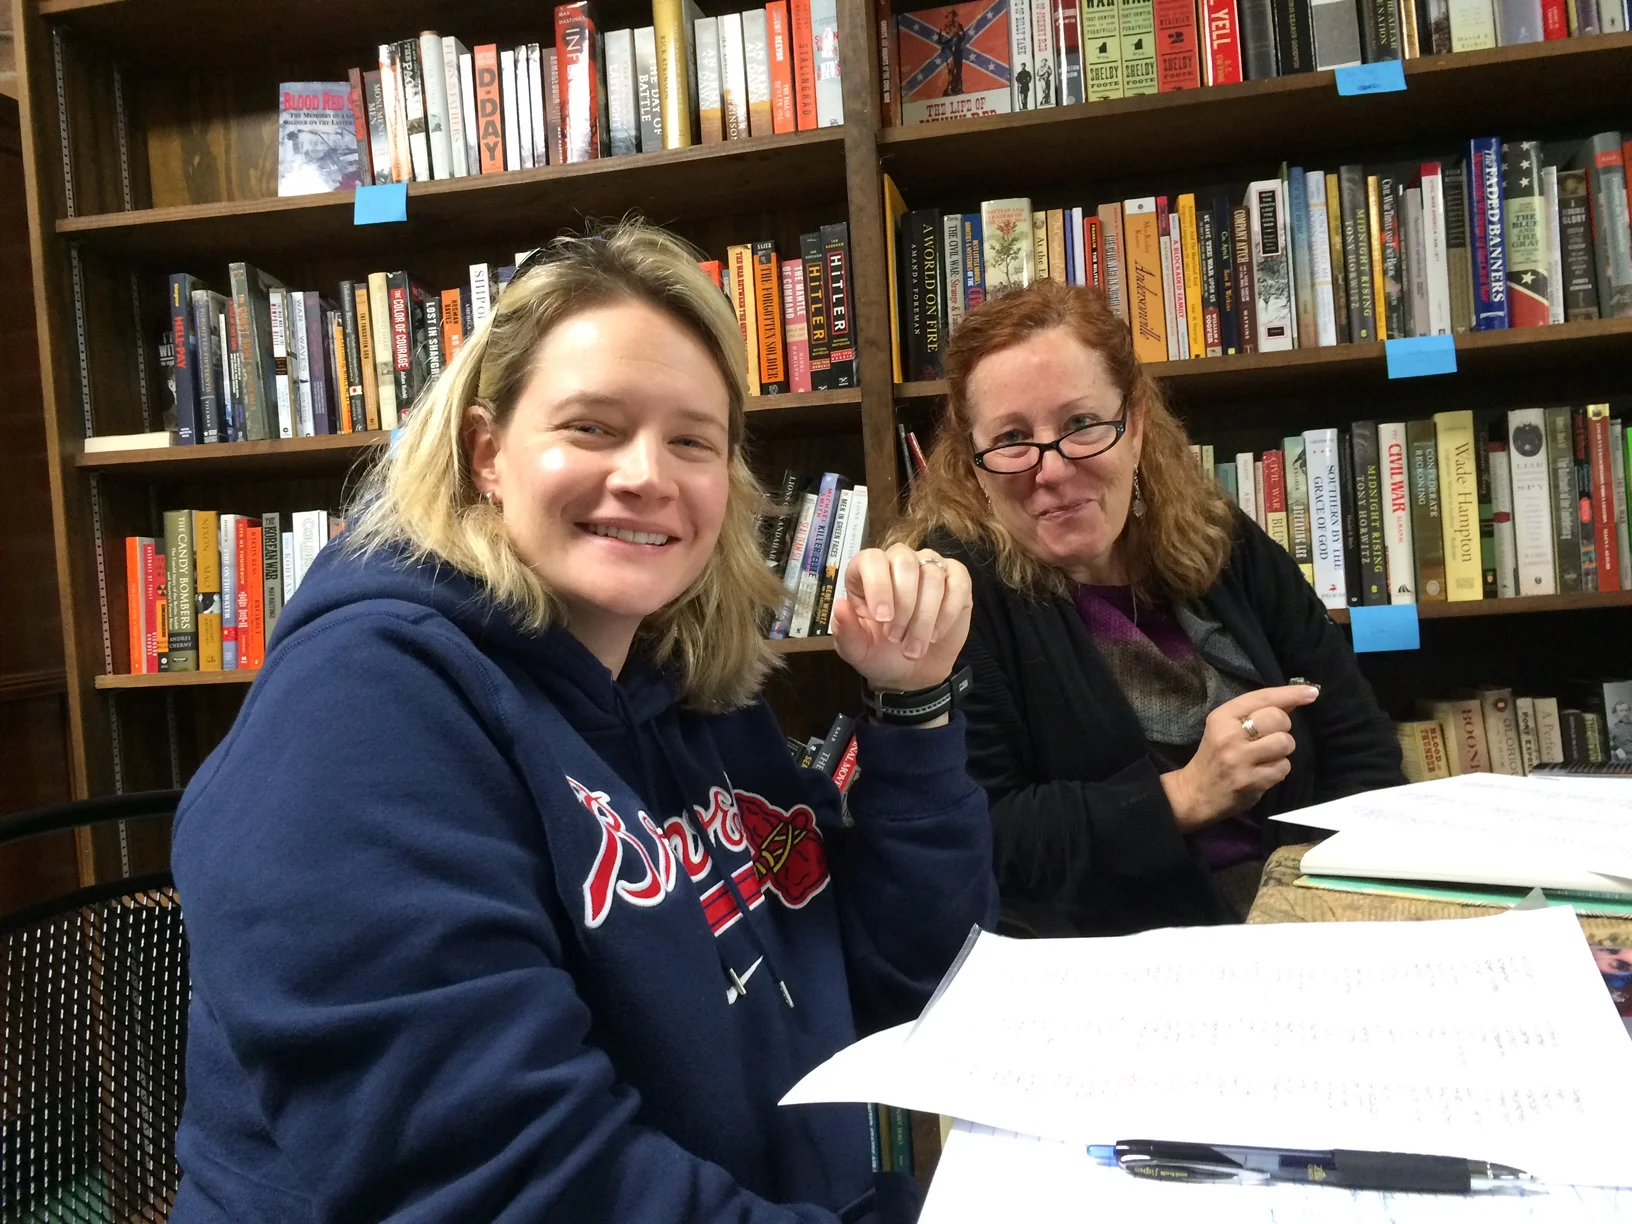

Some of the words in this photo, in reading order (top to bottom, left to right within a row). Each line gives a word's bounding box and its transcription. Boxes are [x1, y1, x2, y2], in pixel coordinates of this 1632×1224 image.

[1211, 8, 1231, 50] YELL
[1377, 8, 1387, 45] NATION
[609, 63, 619, 91] LAST
[1090, 65, 1119, 81] SHELBY
[1125, 62, 1155, 78] SHELBY
[1163, 56, 1193, 72] SHELBY
[1164, 71, 1194, 79] FOOTE
[799, 44, 811, 116] STALINGRAD
[1090, 81, 1120, 89] FOOTE
[1126, 78, 1155, 86] FOOTE
[322, 91, 345, 110] RED
[610, 95, 622, 128] LIGHT
[639, 75, 651, 122] BATTLE
[651, 89, 661, 112] DAY
[926, 104, 947, 117] THE
[950, 100, 972, 114] LIFE
[975, 97, 986, 110] OF
[1486, 167, 1500, 222] FADED
[923, 224, 933, 232] A
[1234, 209, 1247, 240] COMPANY
[1514, 213, 1537, 222] THE
[948, 225, 958, 239] THE
[1037, 237, 1045, 247] At
[1345, 220, 1355, 250] TONY
[1356, 208, 1369, 272] MIDNIGHT
[1515, 233, 1537, 241] THE
[923, 235, 936, 289] WORLD
[949, 240, 959, 258] CIVIL
[1038, 251, 1046, 264] the
[1236, 242, 1249, 263] AYTCH
[761, 267, 773, 285] THE
[782, 266, 791, 275] OF
[794, 266, 804, 282] THE
[911, 243, 919, 283] AMANDA
[1173, 247, 1182, 291] BLOCKADED
[1488, 224, 1504, 302] BANNERS
[474, 270, 485, 303] SHIP
[950, 279, 960, 305] Strange
[1348, 254, 1359, 309] HORWITZ
[784, 276, 794, 319] COMMAND
[795, 284, 806, 316] MANTLE
[925, 294, 937, 315] ON
[1135, 259, 1161, 342] Andersonville
[1209, 295, 1216, 303] US
[1361, 275, 1372, 316] RISING
[394, 299, 405, 323] COLOR
[426, 302, 436, 323] LOST
[451, 299, 459, 324] NORMAN
[762, 287, 776, 340] FORGOTTEN
[913, 288, 921, 334] FOREMAN
[174, 316, 185, 343] HELL
[396, 324, 405, 333] OF
[428, 325, 438, 337] IN
[926, 320, 938, 352] FIRE
[176, 347, 187, 368] PAY
[299, 335, 307, 371] WAVES
[397, 335, 409, 369] COURAGE
[766, 342, 779, 380] SOLDIER
[1268, 457, 1279, 483] CIVIL
[1388, 443, 1404, 480] CIVIL
[1455, 442, 1473, 484] Wade
[786, 476, 796, 500] LIONS
[1356, 475, 1366, 506] TONY
[1415, 450, 1426, 505] RECKONING
[1426, 449, 1437, 517] CONFEDERATE
[816, 493, 825, 519] SMITH
[821, 487, 833, 524] MICHAEL
[1272, 488, 1280, 509] WAR
[1313, 476, 1325, 514] GRACE
[1326, 465, 1340, 525] SOUTHERN
[1367, 465, 1379, 527] MIDNIGHT
[1391, 480, 1406, 513] WAR
[178, 516, 187, 532] THE
[202, 518, 211, 552] NIXON
[834, 519, 844, 540] GREEN
[1293, 505, 1304, 543] DEFEATING
[1317, 516, 1327, 533] OF
[1331, 530, 1340, 542] BY
[1359, 510, 1370, 564] HORWITZ
[1454, 491, 1473, 562] Hampton
[239, 539, 245, 548] ME
[264, 526, 278, 561] KOREAN
[815, 525, 826, 553] KILLER
[830, 540, 839, 557] FACES
[1295, 545, 1306, 558] LEE
[1318, 535, 1328, 560] GOD
[177, 534, 189, 574] CANDY
[1333, 549, 1342, 570] THE
[1371, 532, 1382, 573] RISING
[203, 565, 211, 588] MAO
[224, 566, 230, 577] ON
[265, 562, 278, 580] WAR
[284, 552, 292, 595] KOREAN
[808, 555, 821, 578] ELITE
[179, 577, 190, 629] BOMBERS
[825, 584, 833, 602] GENE
[820, 603, 830, 625] WENTZ
[1521, 712, 1530, 735] PONY
[1421, 728, 1436, 773] THUNDER
[1430, 727, 1442, 763] BLOOD
[816, 752, 830, 771] THE
